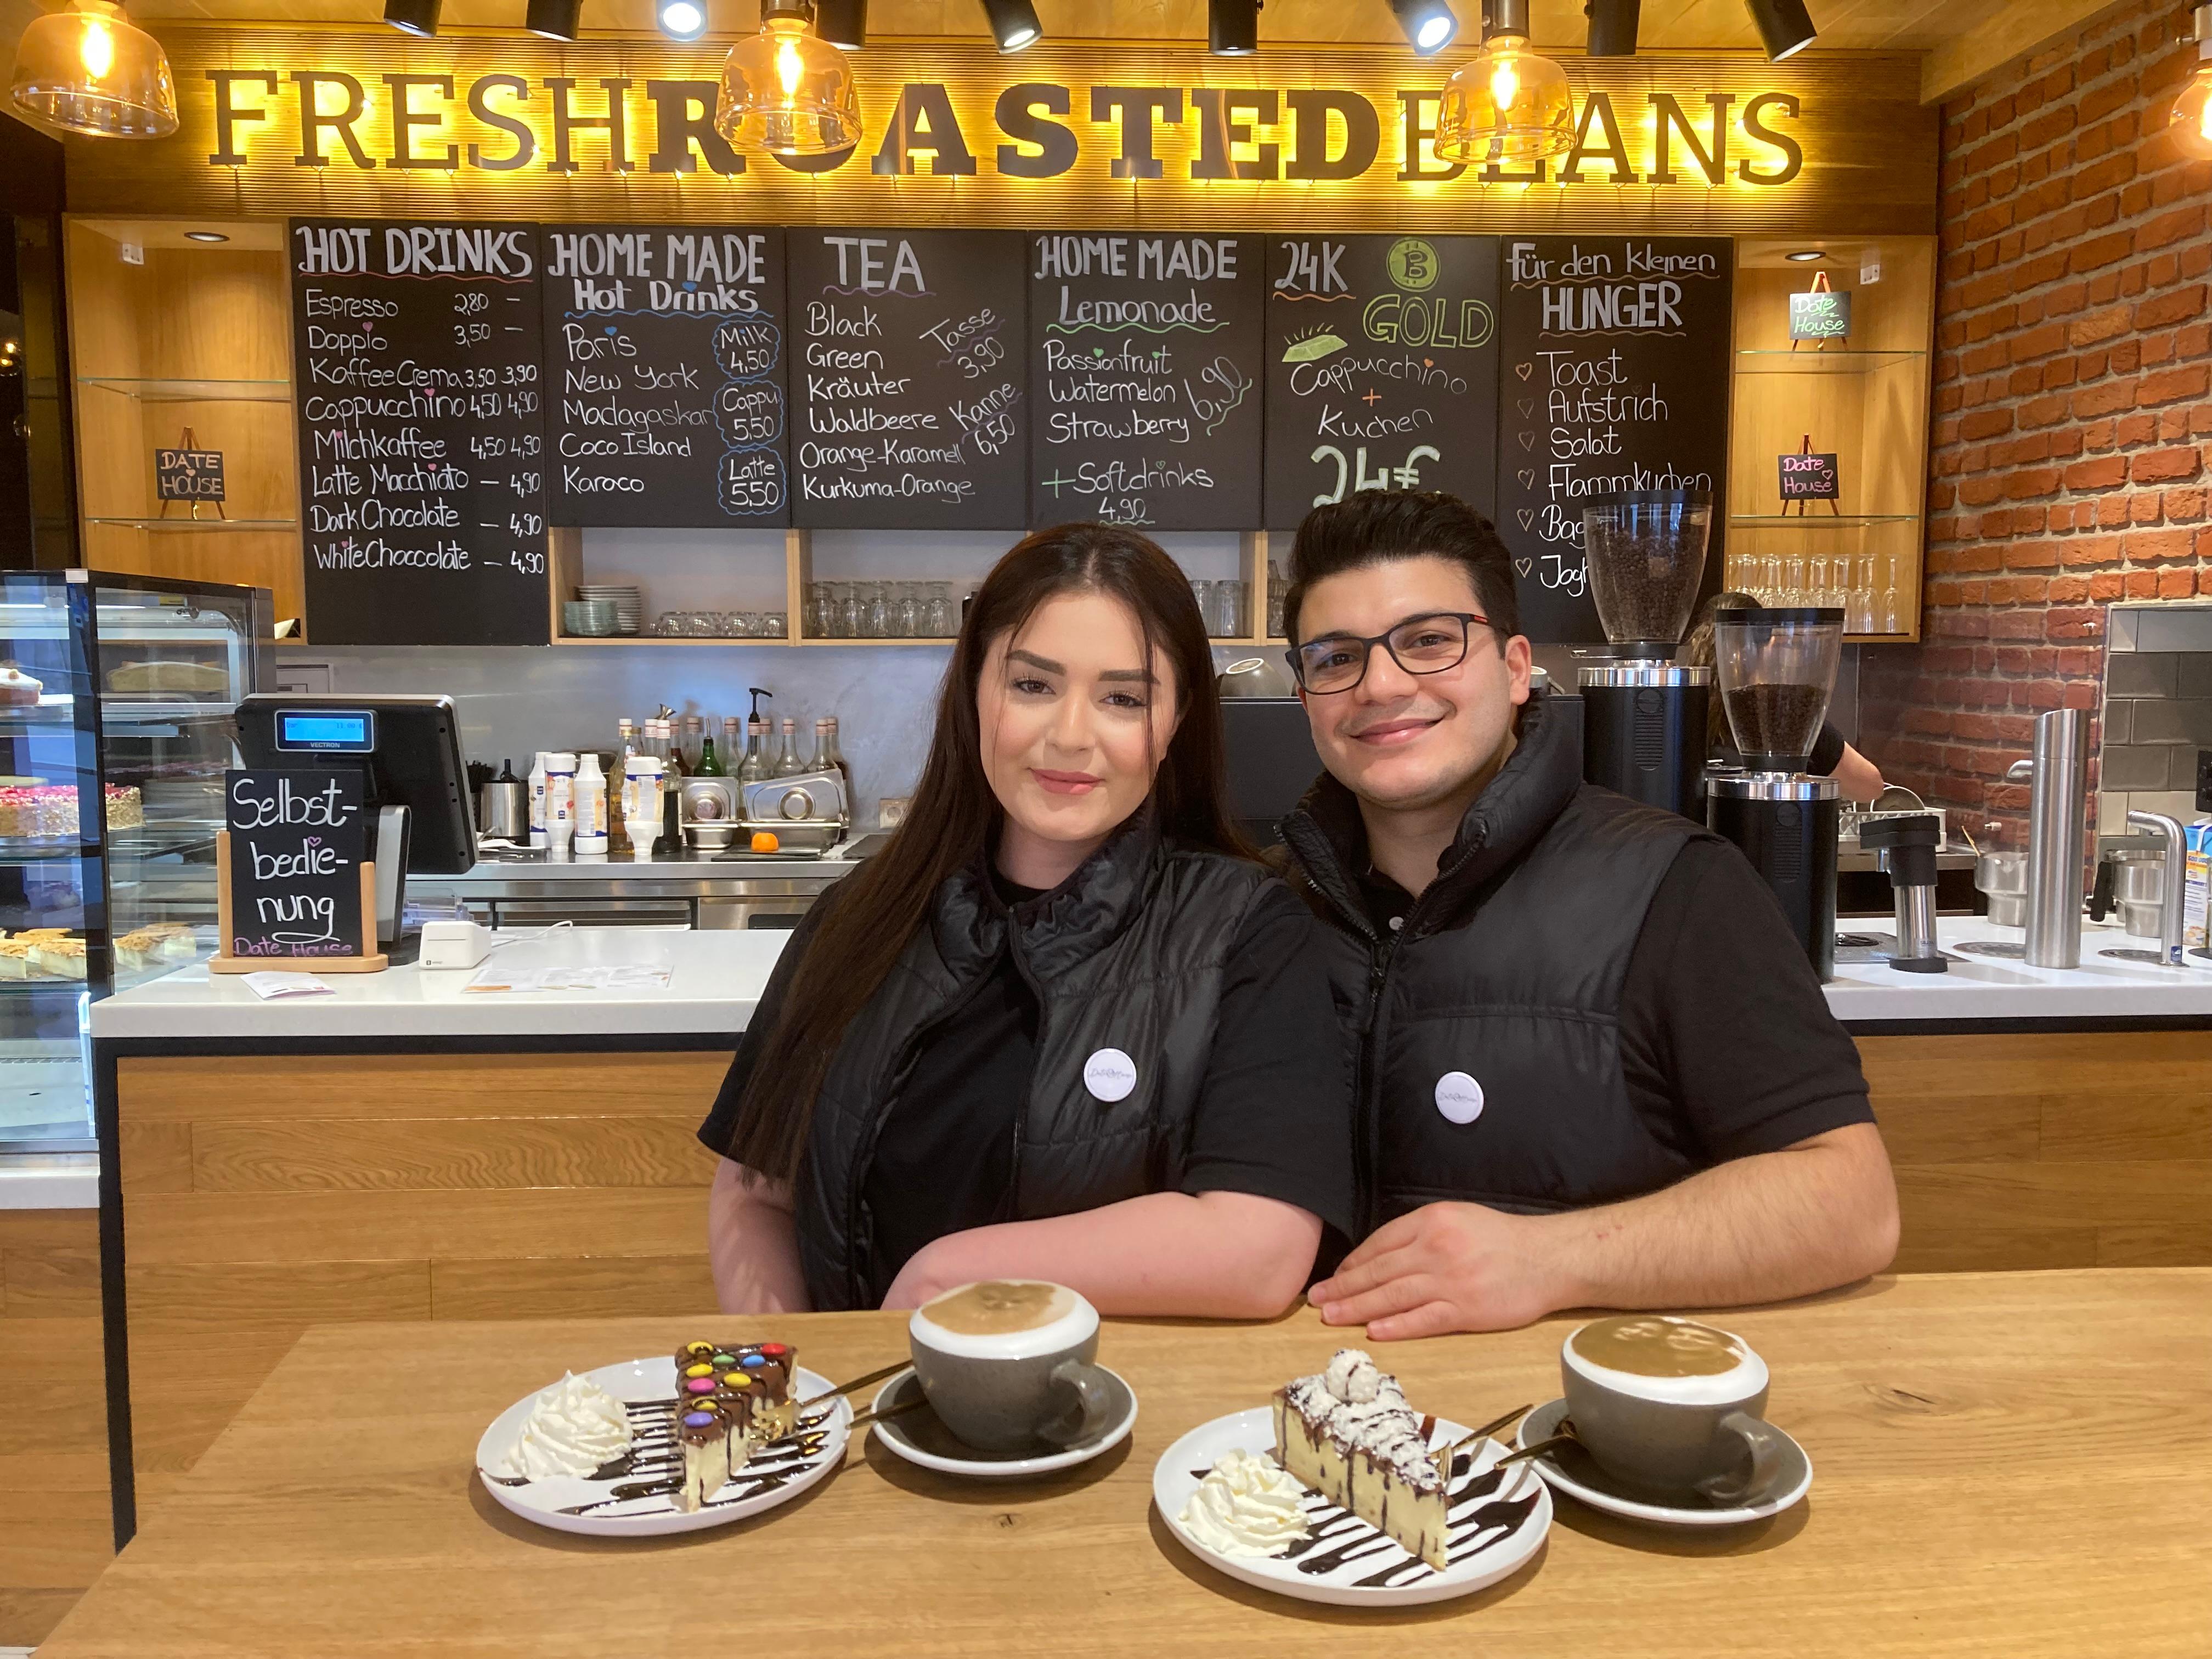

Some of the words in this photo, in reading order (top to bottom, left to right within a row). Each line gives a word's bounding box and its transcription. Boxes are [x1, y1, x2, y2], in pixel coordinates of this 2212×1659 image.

[296, 226, 370, 273] HOT
[386, 227, 533, 278] DRINKS
[548, 234, 653, 277] HOME
[667, 234, 766, 284] MADE
[824, 236, 926, 292] TEA
[1034, 236, 1128, 279] HOME
[1138, 238, 1238, 281] MADE
[1274, 241, 1348, 292] 24K
[1506, 242, 1555, 281] Für
[1561, 244, 1611, 275] den
[306, 289, 398, 319] Espresso
[454, 293, 489, 315] 2,80
[574, 279, 632, 311] Hot
[650, 280, 759, 313] Drinks
[1059, 286, 1216, 325] Lemonade
[1542, 280, 1683, 331] HUNGER
[1795, 294, 1837, 313] Date
[805, 301, 882, 336] Black
[919, 308, 995, 353] Tasse
[1363, 294, 1494, 348] GOLD
[1795, 317, 1844, 333] House
[308, 325, 387, 356] Doppio
[454, 324, 490, 347] 3,50
[562, 323, 637, 362] Paris
[720, 326, 772, 349] Milk
[730, 348, 769, 374] 4,50
[806, 342, 883, 369] Green
[957, 337, 1005, 379] 3,90
[1042, 338, 1172, 374] Passionfruit
[1536, 348, 1628, 388] Toast
[465, 369, 496, 388] 3,50
[500, 365, 537, 386] 3,90
[566, 366, 621, 394] New
[634, 363, 699, 390] York
[808, 371, 910, 401] Kräuter
[1049, 374, 1176, 404] Watermelon
[470, 392, 501, 419] 4,50
[508, 391, 538, 419] 4,90
[563, 396, 713, 435] Madagaskar
[949, 383, 1015, 431] Kanne
[1548, 383, 1668, 422] Aufstrich
[733, 416, 774, 441] 5,50
[809, 407, 939, 433] Waldbeere
[974, 414, 1015, 455] 6,50
[1046, 409, 1189, 443] Strawberry
[1318, 404, 1434, 438] Kuchen
[314, 427, 447, 460] Milchkaffee
[471, 437, 506, 460] 4,50
[511, 435, 540, 460] 4,90
[559, 433, 618, 458] Coco
[621, 433, 691, 457] Island
[1550, 425, 1622, 459] Salat
[161, 452, 220, 469] DATE
[729, 455, 775, 481] Latte
[1784, 456, 1824, 472] Date
[162, 476, 223, 496] HOUSE
[313, 464, 362, 497] Latte
[370, 462, 469, 495] Macchiato
[511, 472, 540, 498] 4,90
[730, 481, 779, 506] 5,50
[1784, 477, 1832, 493] House
[510, 514, 542, 537] 4,90
[1098, 496, 1146, 521] 4,90
[511, 551, 544, 574] 4,90
[233, 778, 358, 829] Selbst-
[250, 838, 349, 879] bedie-
[256, 895, 341, 944] nung
[233, 936, 283, 956] Date
